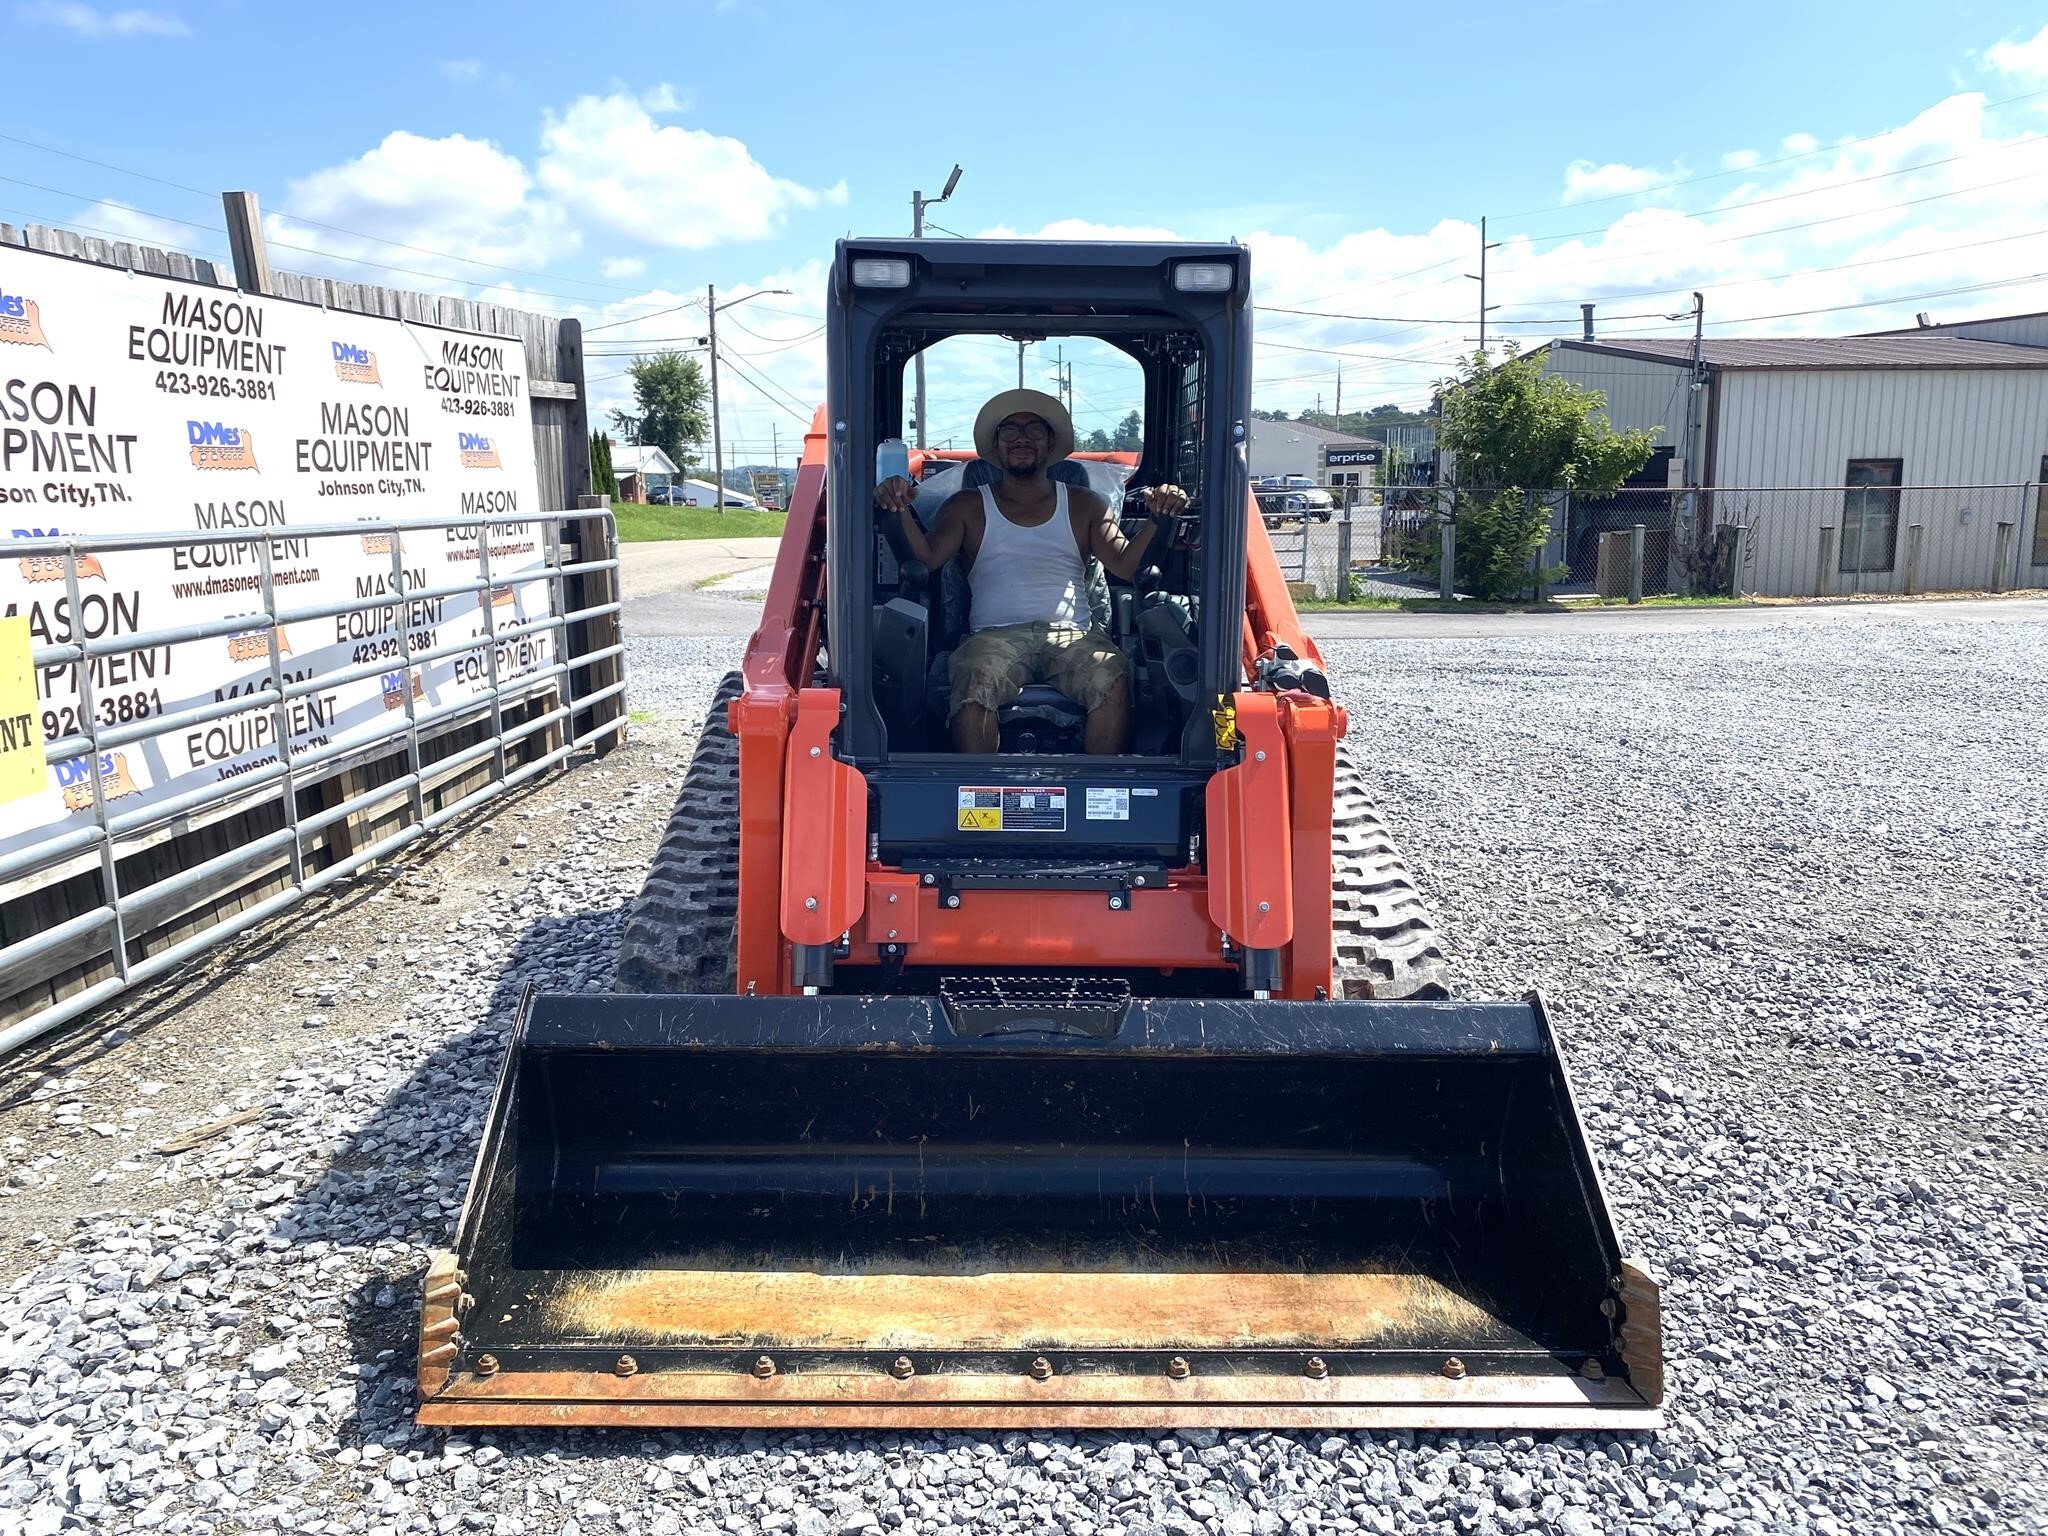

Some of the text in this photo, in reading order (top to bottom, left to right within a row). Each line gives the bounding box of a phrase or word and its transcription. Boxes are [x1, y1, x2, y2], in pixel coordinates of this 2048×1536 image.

[162, 291, 263, 338] MASON
[128, 325, 286, 375] EQUIPMENT
[442, 341, 504, 371] MASON
[155, 371, 276, 401] 423-926-3881
[424, 365, 520, 398] EQUIPMENT
[321, 402, 409, 437] MASON
[441, 397, 515, 417] 423-926-3881
[3, 428, 137, 474] PMENT
[296, 439, 432, 473] EQUIPMENT
[1329, 452, 1376, 464] erprise
[0, 487, 38, 504] son
[318, 480, 375, 497] Johnson
[461, 490, 517, 515] MASON
[194, 500, 286, 530] MASON
[4, 591, 139, 645] ASON
[353, 629, 437, 664] 423-923881
[454, 638, 546, 685] EQUPMENT
[0, 713, 33, 753] NT
